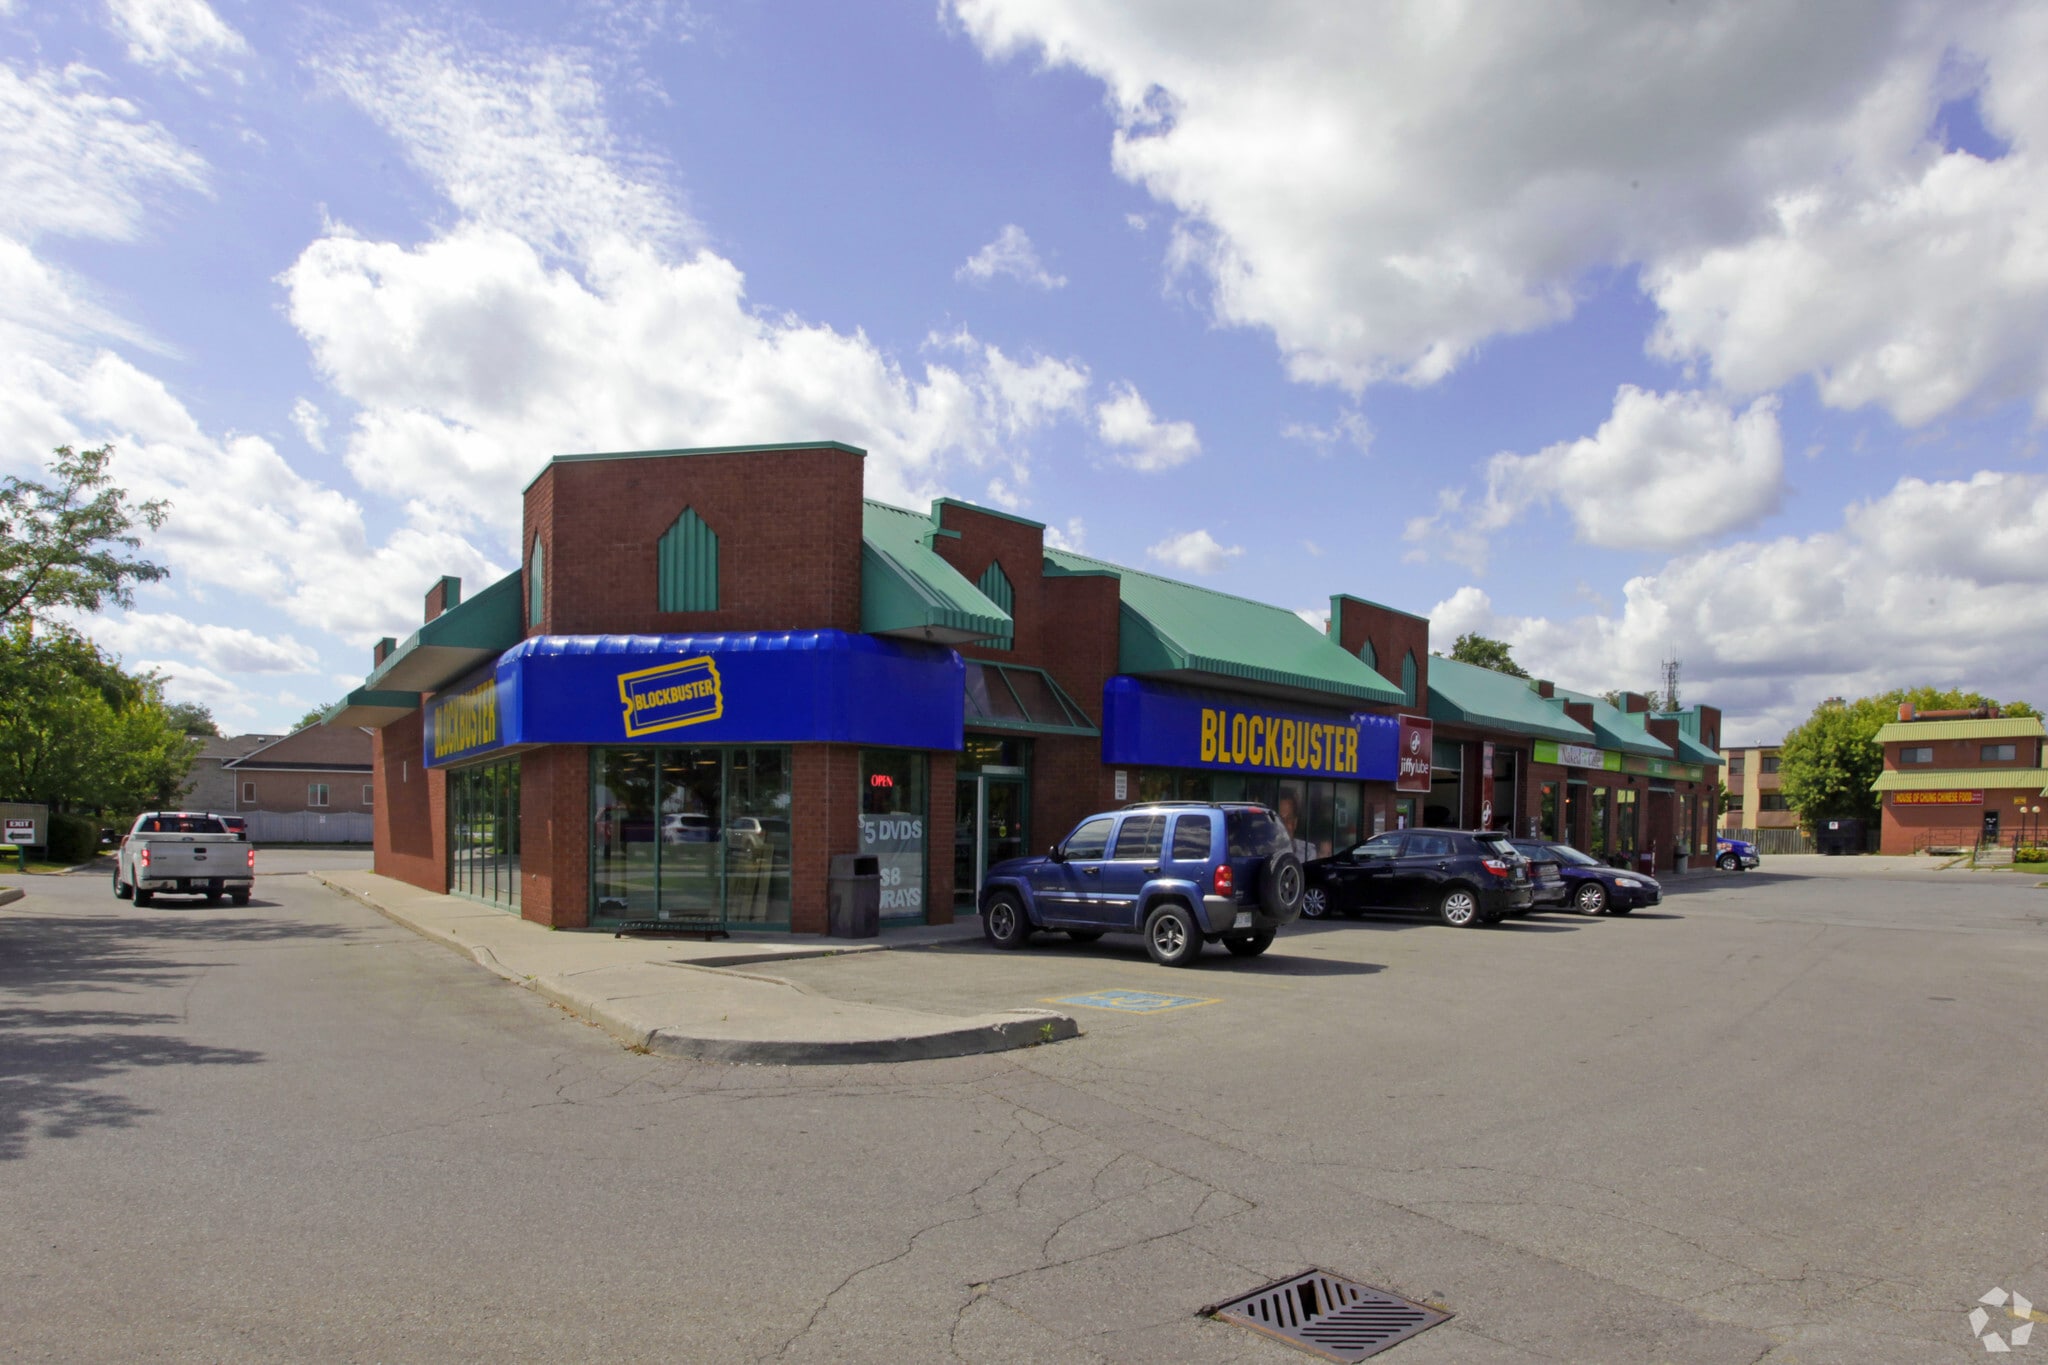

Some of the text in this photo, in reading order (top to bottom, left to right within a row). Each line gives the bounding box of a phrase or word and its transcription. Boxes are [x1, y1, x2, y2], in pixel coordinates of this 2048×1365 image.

[634, 679, 715, 711] BLOCKBUSTER
[1200, 708, 1359, 773] BLOCKBUSTER
[1400, 757, 1429, 777] jiffy lube
[870, 774, 893, 787] OPEN
[1959, 791, 1973, 802] FOOD
[879, 819, 922, 840] DVDS
